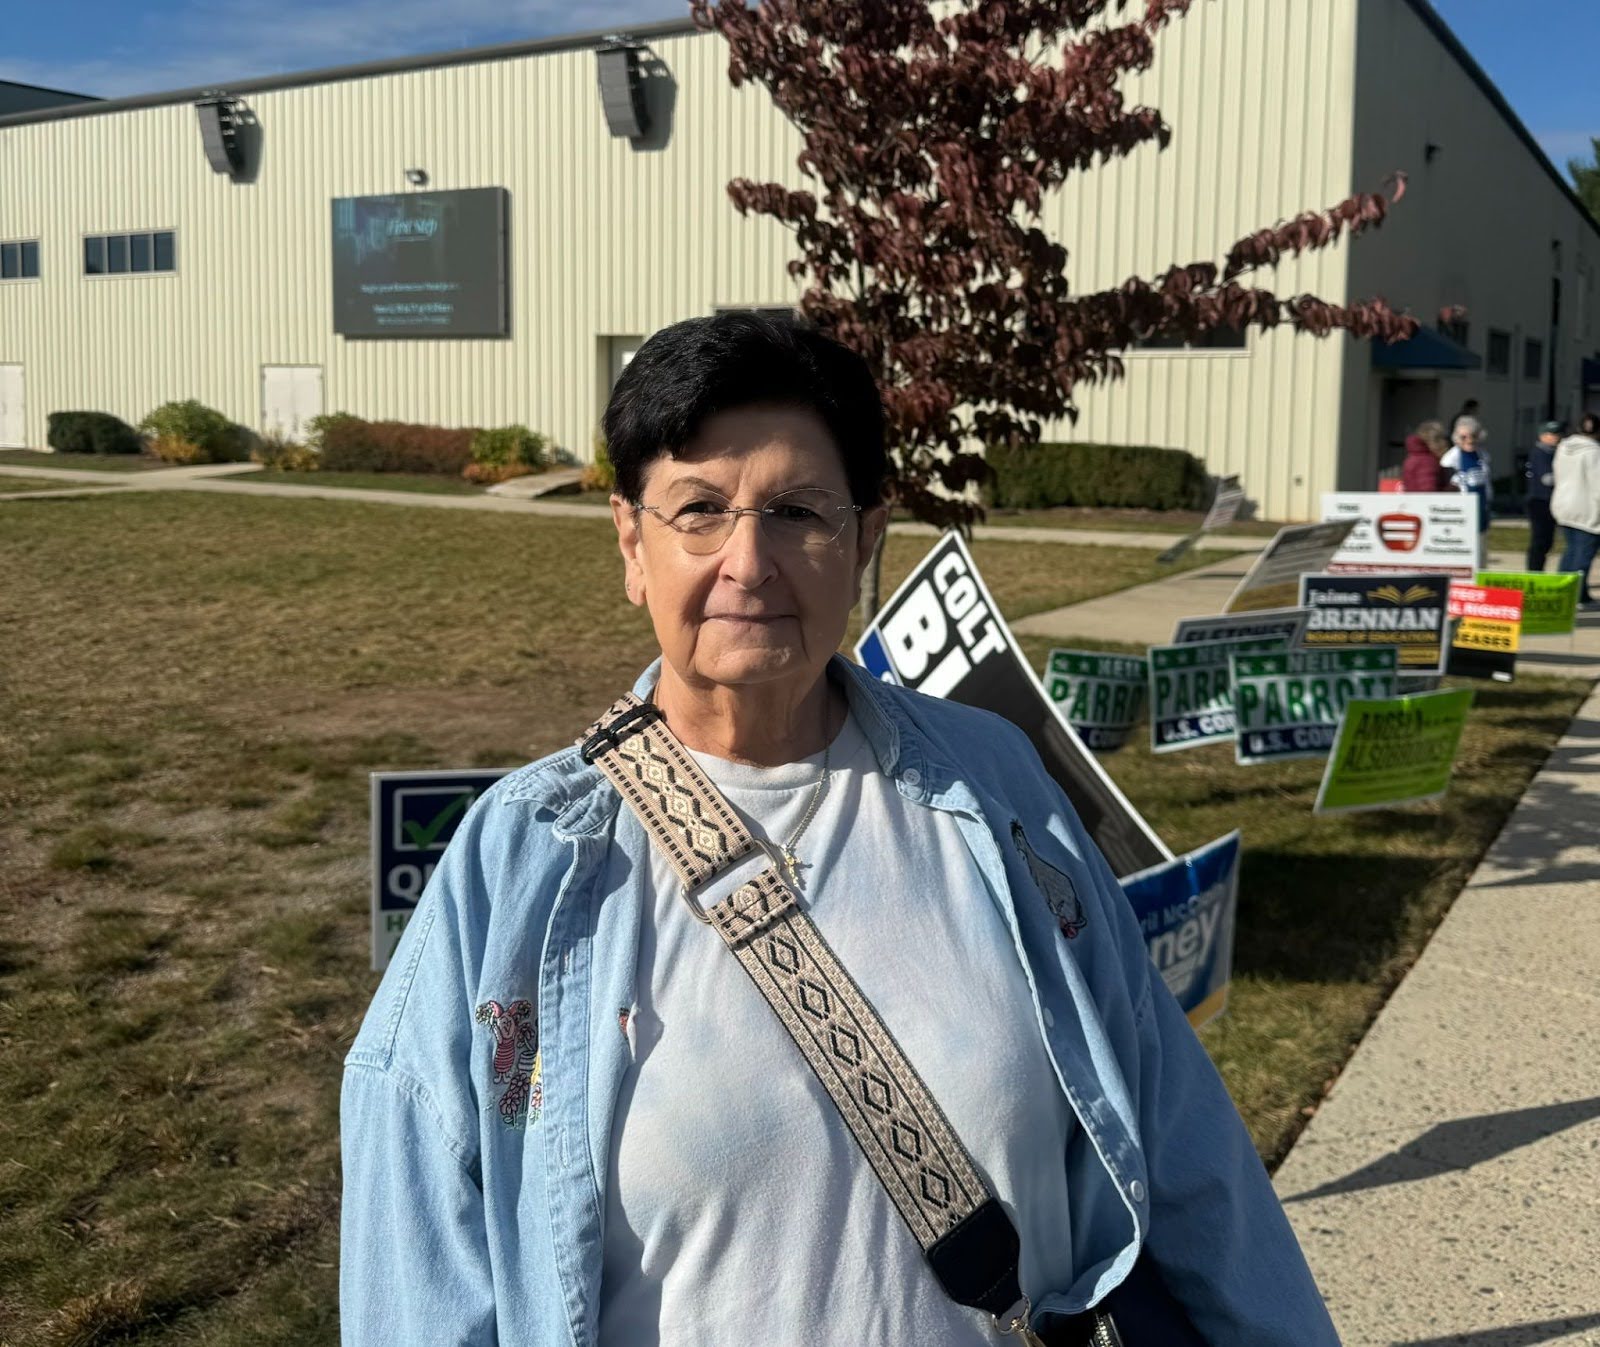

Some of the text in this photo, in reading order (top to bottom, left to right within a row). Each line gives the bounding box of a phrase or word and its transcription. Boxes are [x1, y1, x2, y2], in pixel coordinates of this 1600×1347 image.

[933, 551, 1007, 665] COLT
[1306, 607, 1440, 631] BRENNAN
[1288, 651, 1341, 674] NEIL
